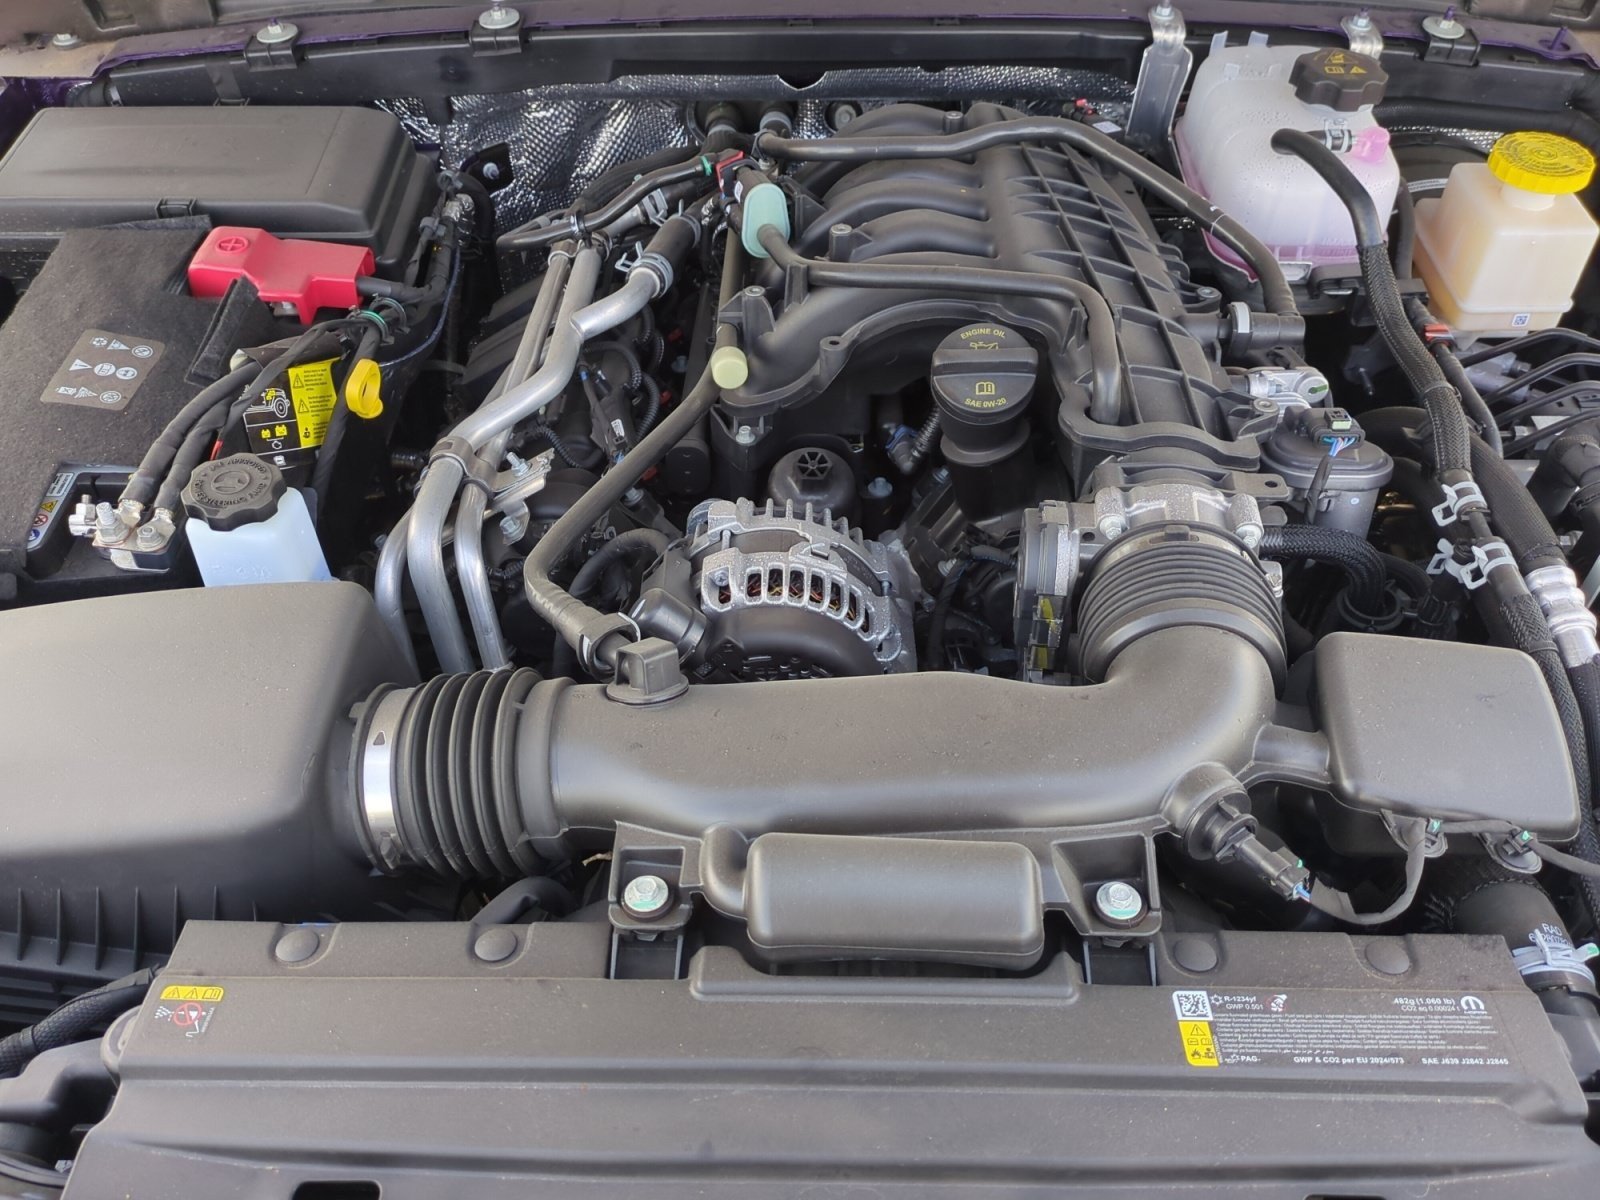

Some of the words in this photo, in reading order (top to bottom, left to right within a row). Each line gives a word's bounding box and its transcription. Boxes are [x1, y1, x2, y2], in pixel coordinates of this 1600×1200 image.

[960, 327, 991, 340] ENGINE
[993, 328, 1007, 339] OIL
[964, 397, 982, 408] SAE
[983, 397, 1007, 408] 0W-20
[1541, 922, 1563, 936] RAD
[1393, 997, 1415, 1006] 482g
[1443, 997, 1455, 1006] lb)
[1293, 1056, 1313, 1064] GWP
[1341, 1057, 1355, 1065] per
[1421, 1057, 1439, 1065] SAE
